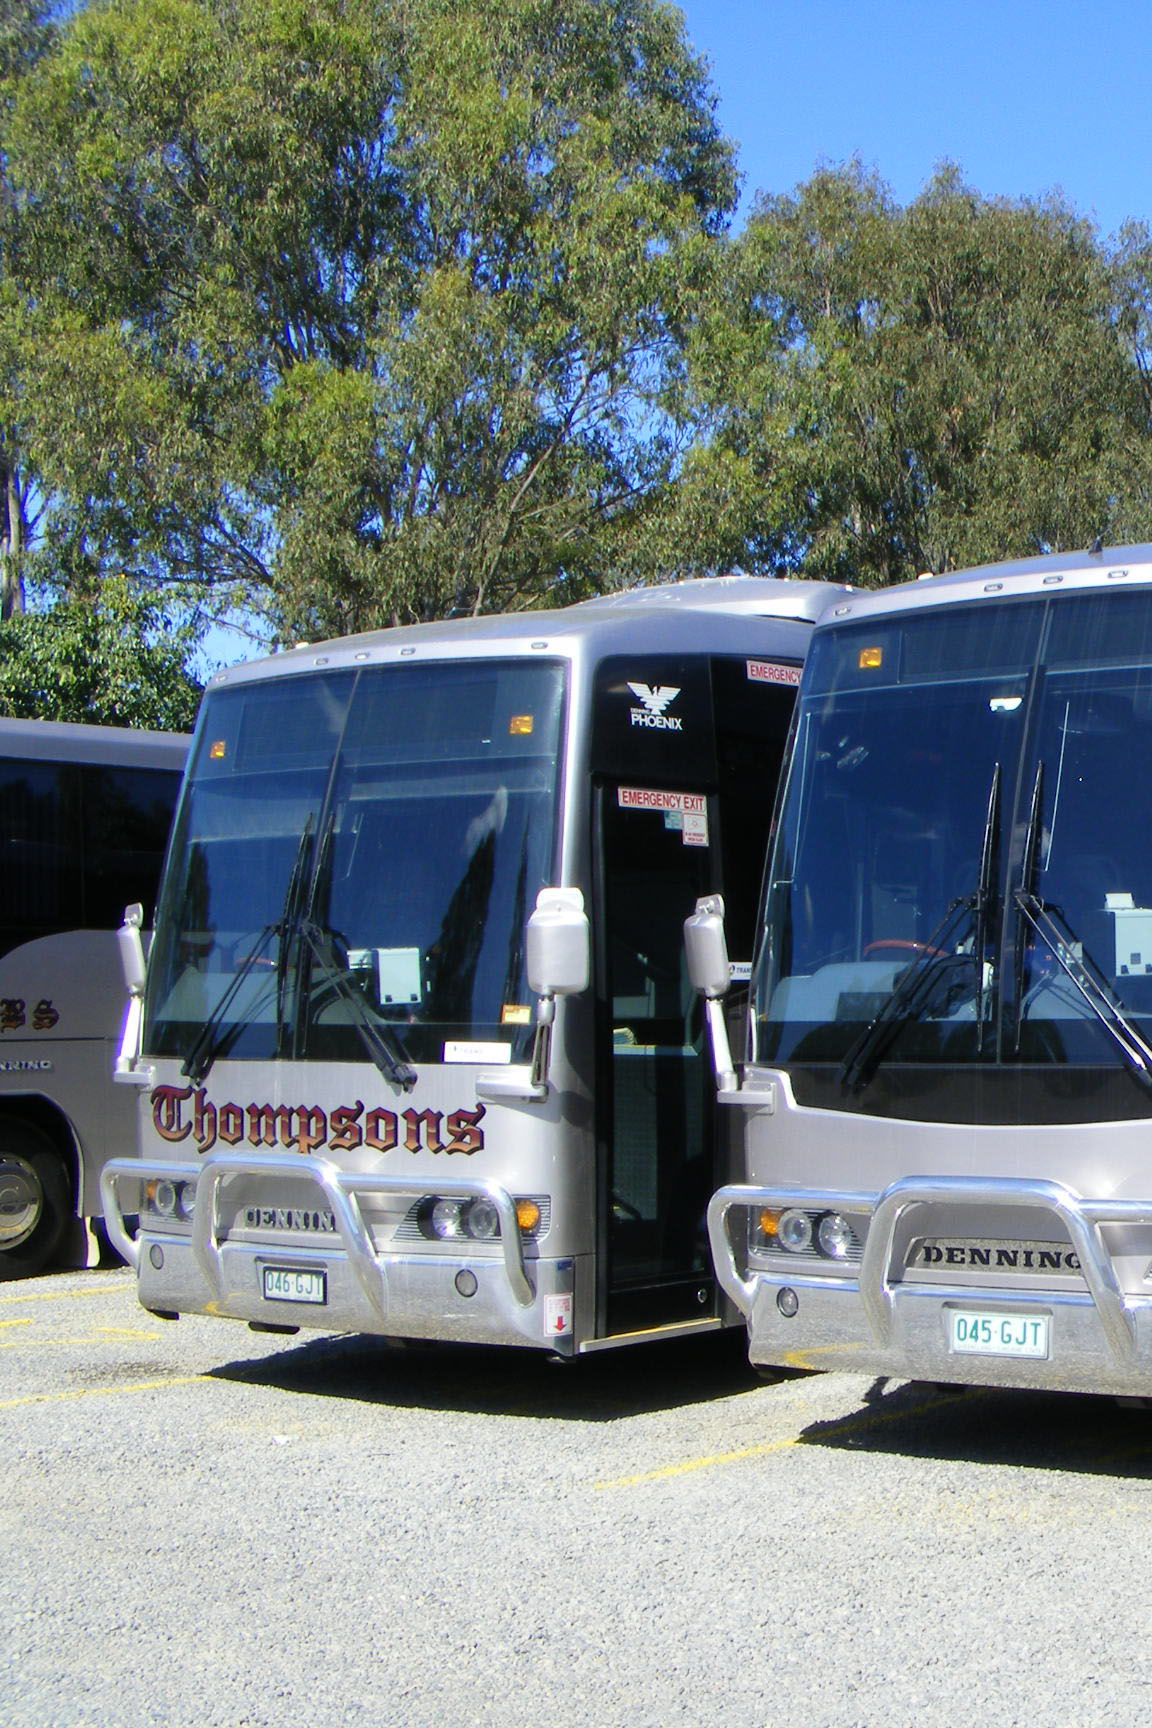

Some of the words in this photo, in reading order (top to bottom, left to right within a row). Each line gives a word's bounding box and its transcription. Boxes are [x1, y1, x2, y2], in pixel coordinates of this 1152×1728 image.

[631, 713, 683, 730] PHOENIX
[621, 790, 682, 808] EMERGENCY
[684, 796, 705, 811] EXIT
[151, 1085, 487, 1155] Thompsons
[244, 1208, 337, 1232] DENNIN
[922, 1246, 1081, 1269] DENNING
